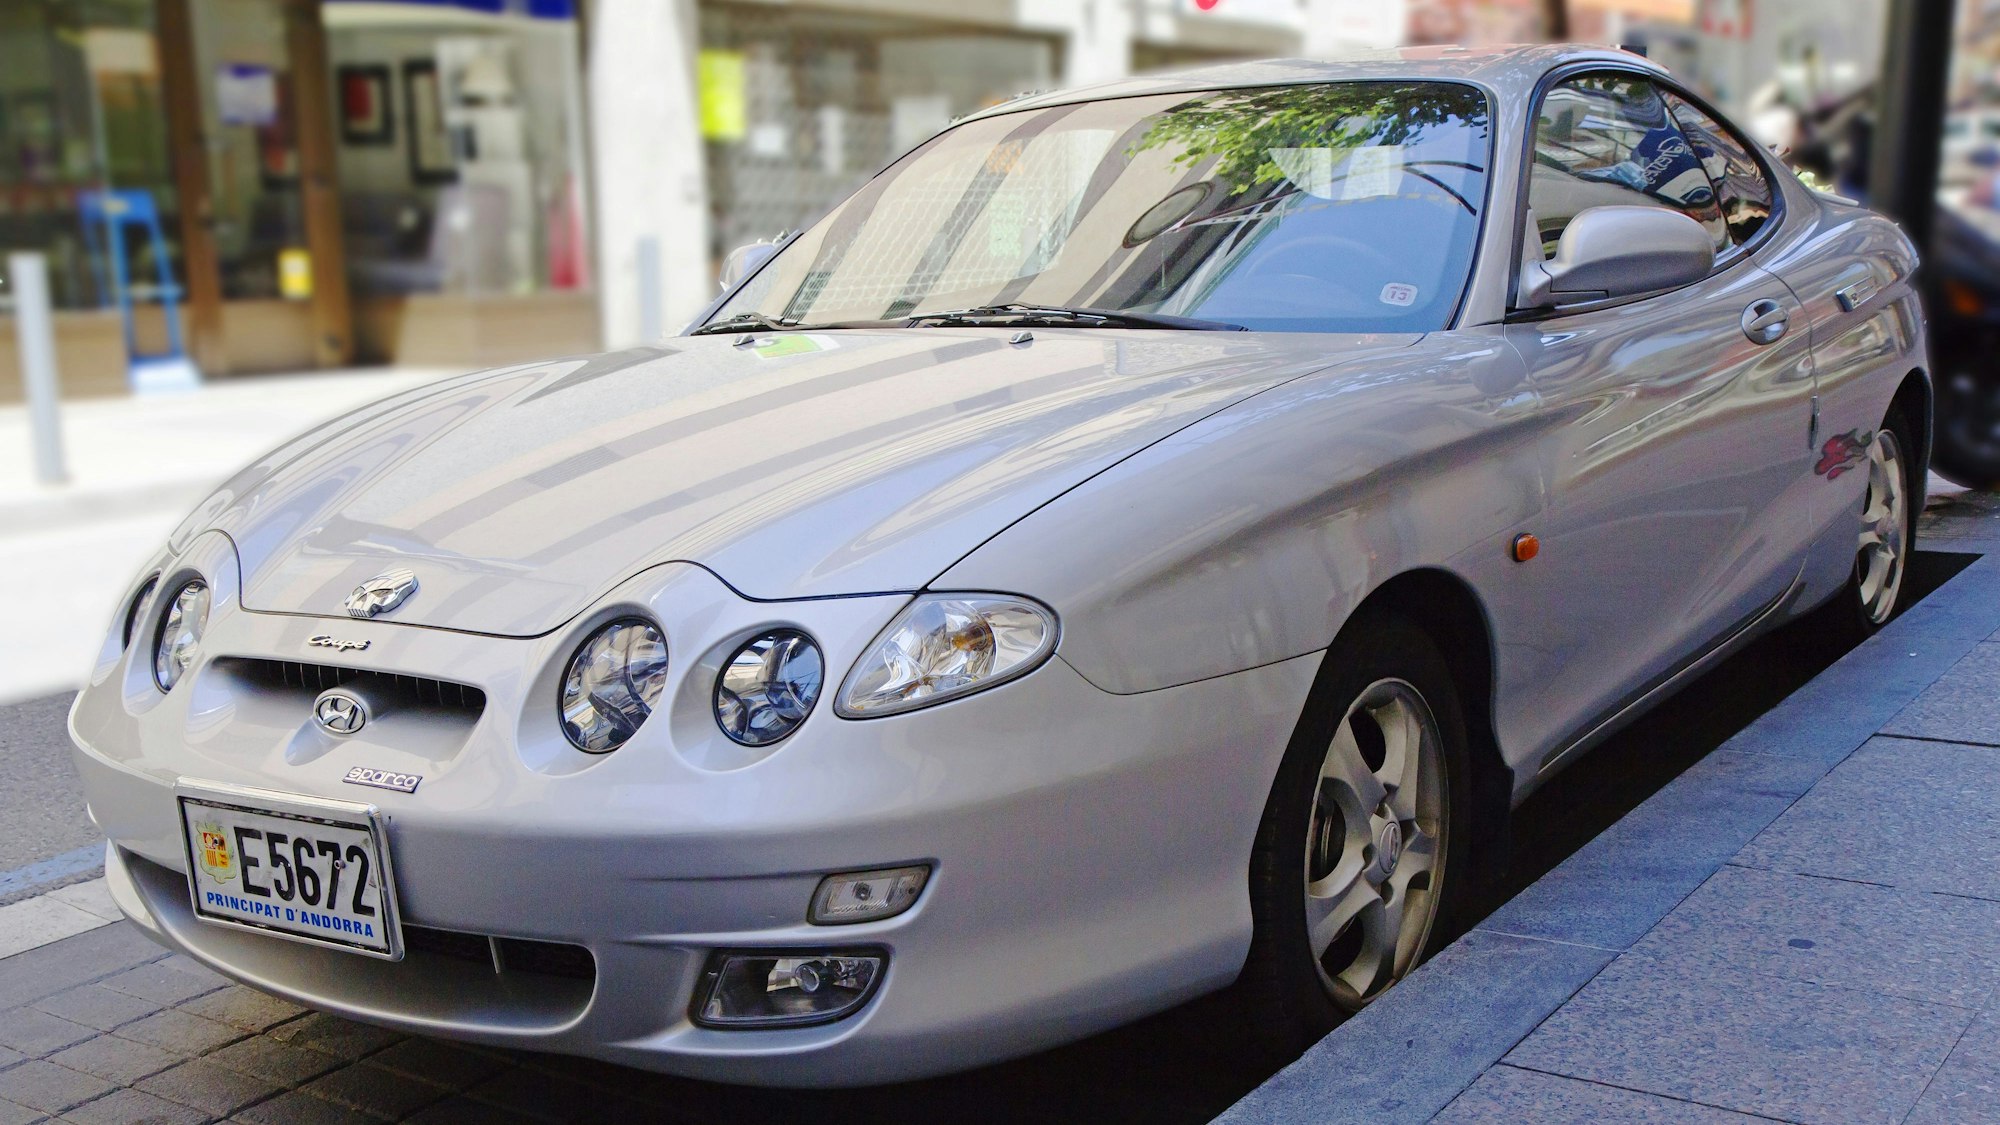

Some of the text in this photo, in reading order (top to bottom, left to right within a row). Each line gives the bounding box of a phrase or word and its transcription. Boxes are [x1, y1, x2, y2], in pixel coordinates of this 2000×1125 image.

[348, 766, 418, 788] sparco
[233, 826, 376, 918] E5672
[206, 892, 374, 938] PRINCIPAT D'ANDORRA
